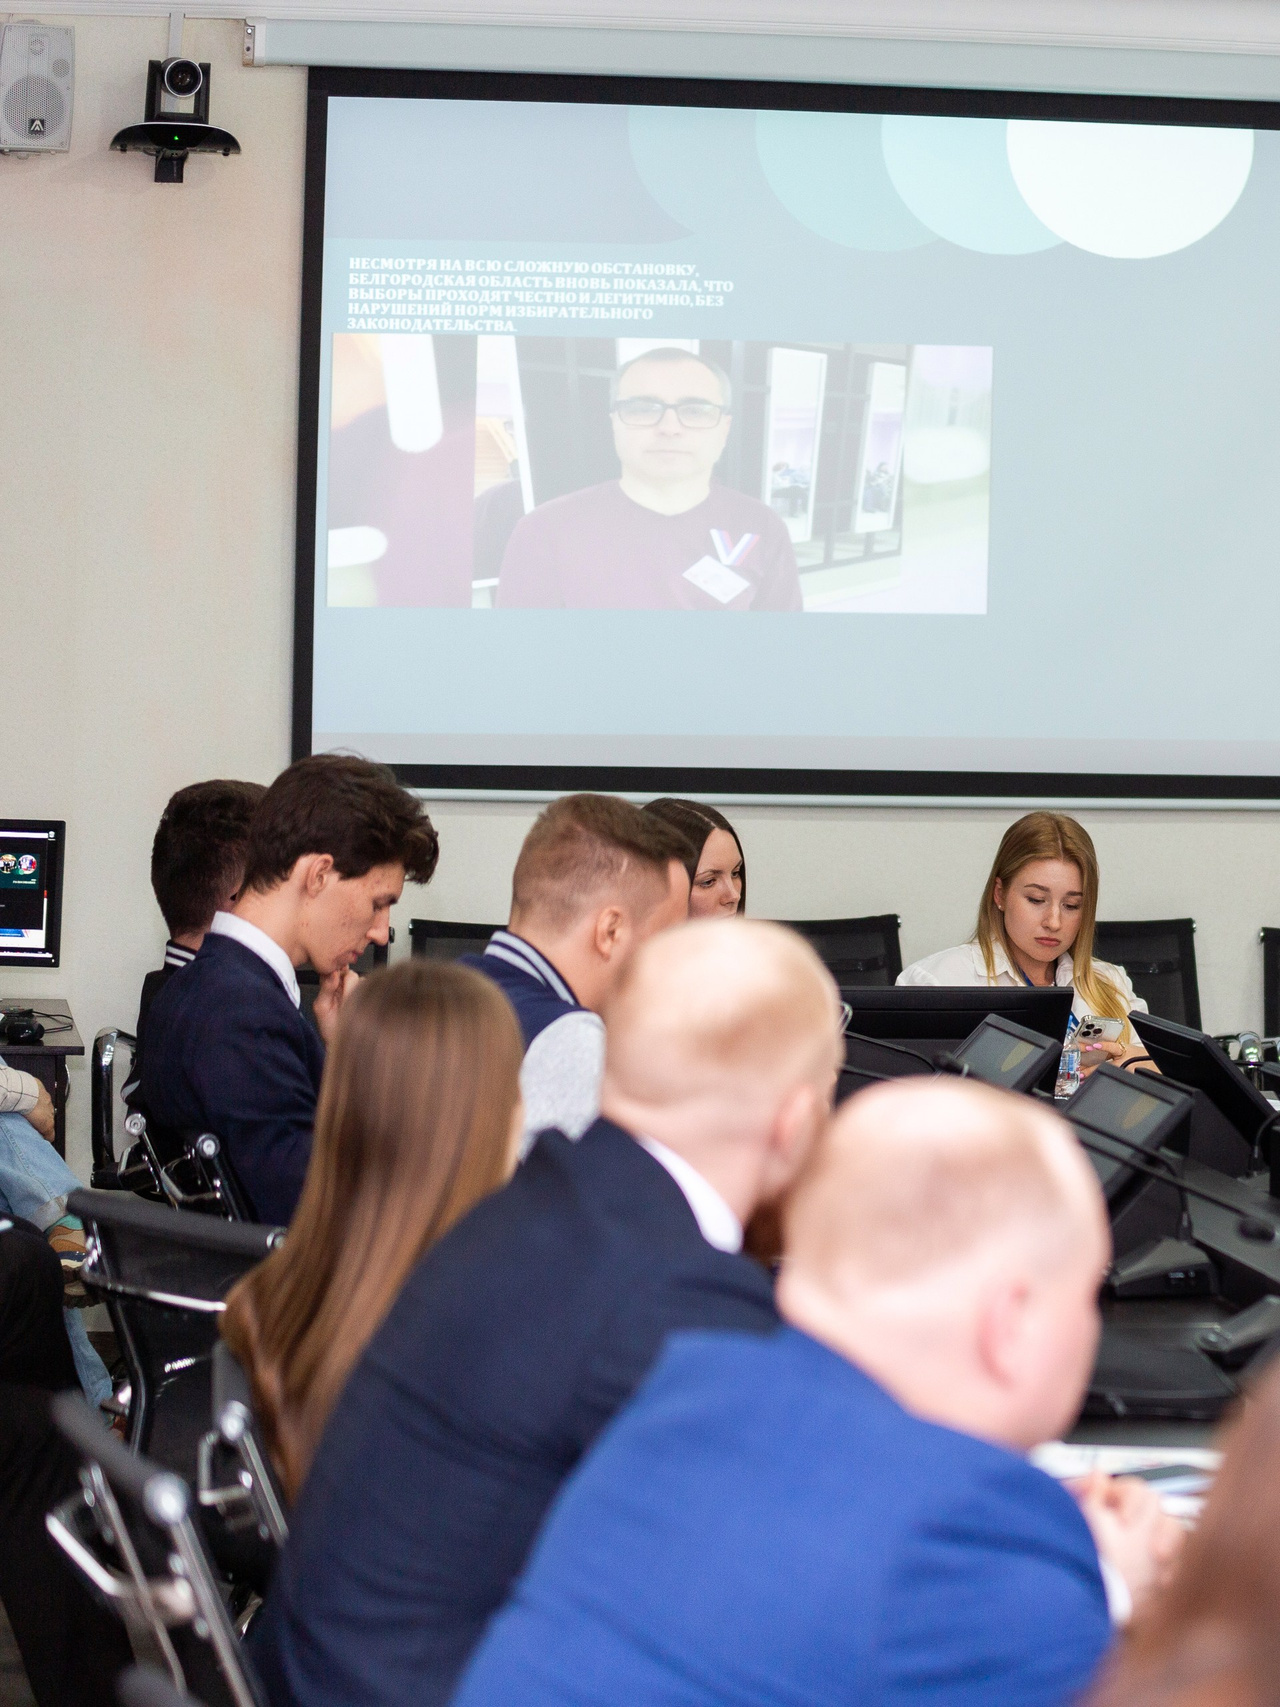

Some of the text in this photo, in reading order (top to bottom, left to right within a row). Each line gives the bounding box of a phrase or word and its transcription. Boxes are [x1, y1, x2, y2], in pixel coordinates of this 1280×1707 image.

[349, 257, 437, 271] НЕСМОТРЯ
[440, 259, 462, 272] НА
[465, 259, 501, 273] ВСЮ
[504, 260, 589, 274] СЛОЖНУЮ
[349, 273, 733, 293] БЕЛГОРОДСКАЯ ОБЛАСТЬ ВНОВЬ ПОКАЗАЛА, ЧТО
[348, 288, 723, 308] ВЫБОРЫ ПРОХОДЯТ ЧЕСТНО И ЛЕГИТИМНО, БЕЗ
[347, 302, 653, 320] НАРУШЕНИЙ НОРМ ИЗБИРАТЕЛЬНОГО
